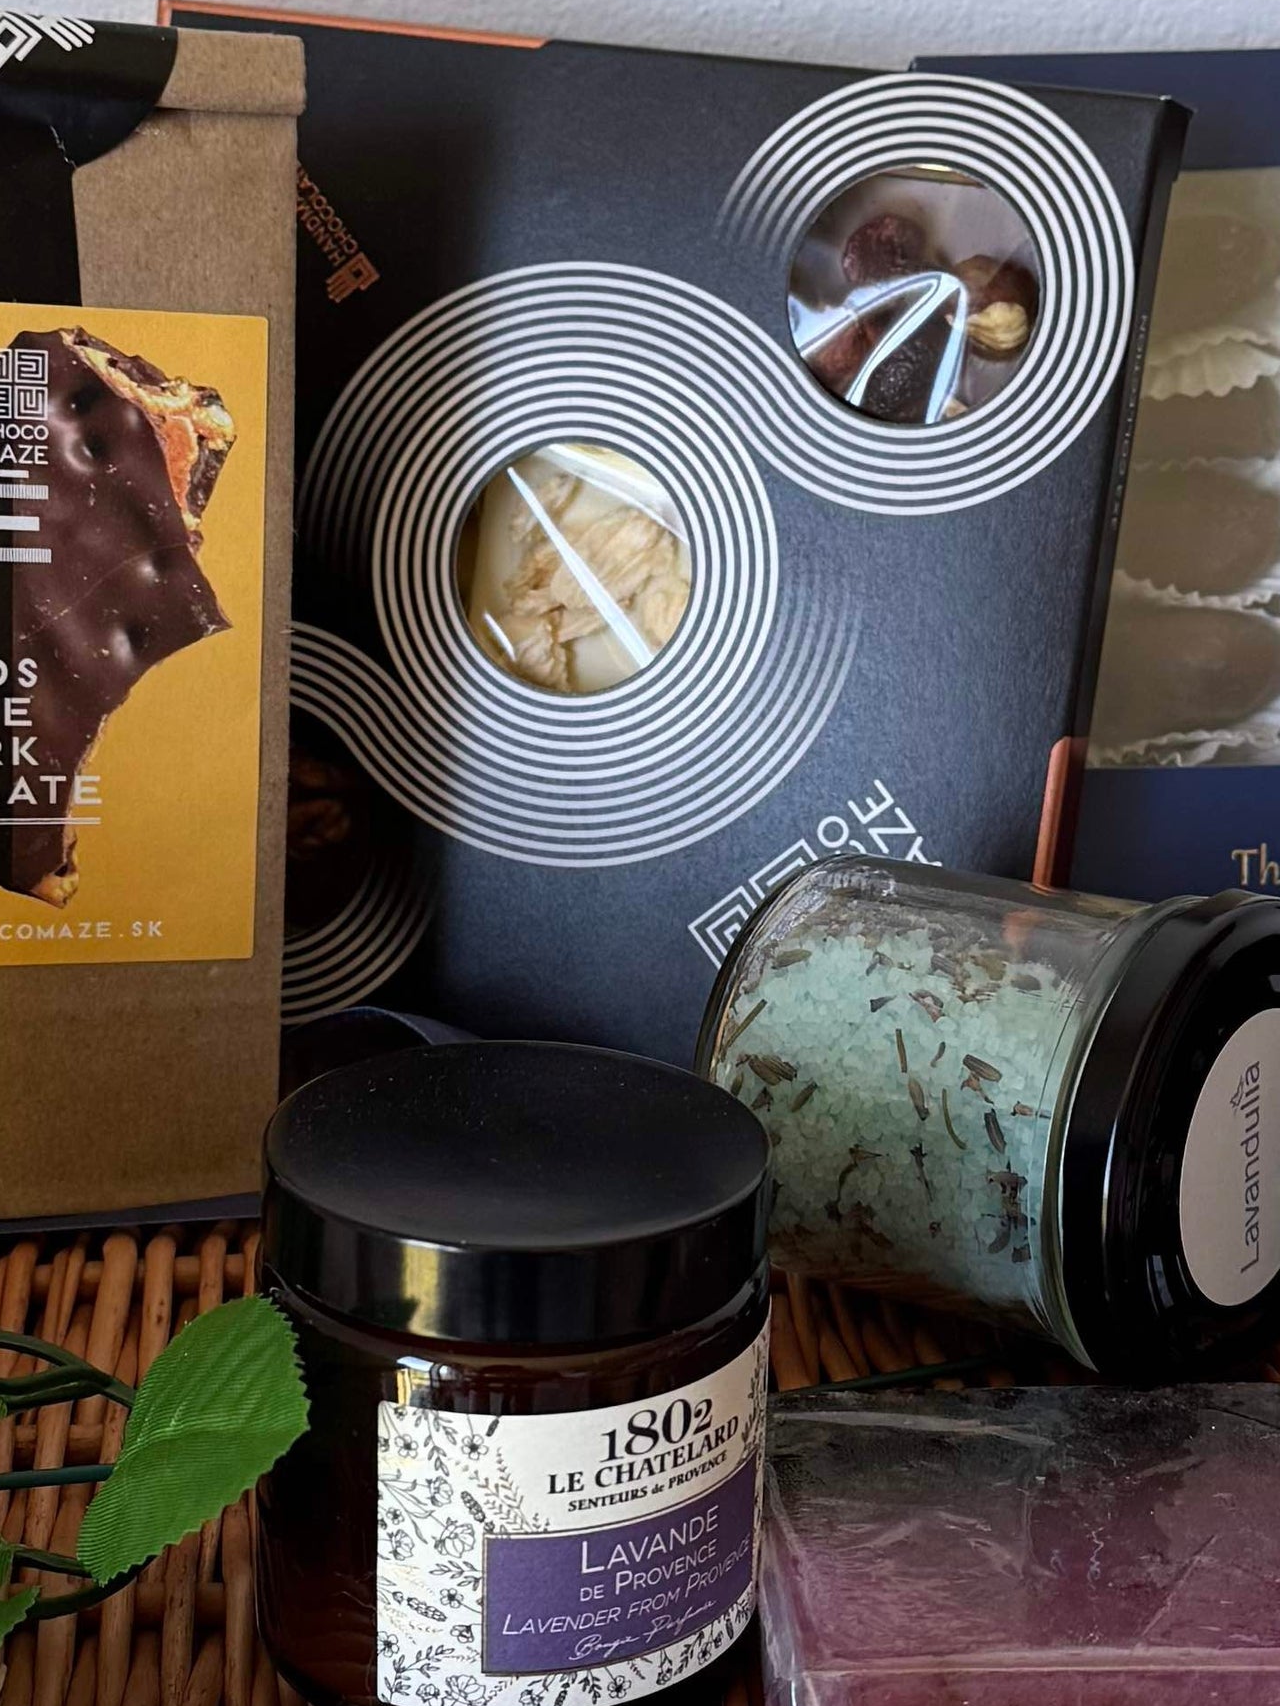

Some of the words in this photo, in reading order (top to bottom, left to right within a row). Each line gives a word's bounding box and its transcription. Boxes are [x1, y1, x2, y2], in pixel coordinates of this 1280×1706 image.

[1239, 1059, 1261, 1274] Lavandulia
[546, 1470, 586, 1496] LE
[594, 1414, 740, 1489] CHATELARD
[598, 1397, 715, 1464] 1802
[568, 1485, 650, 1513] SENTEURS
[650, 1481, 666, 1495] de
[667, 1449, 729, 1491] PROVENCE
[579, 1584, 605, 1602] DE
[614, 1538, 719, 1596] PROVENCE
[580, 1504, 721, 1575] LAVANDE
[501, 1605, 622, 1636] LAVENDER
[626, 1586, 682, 1620] FROM
